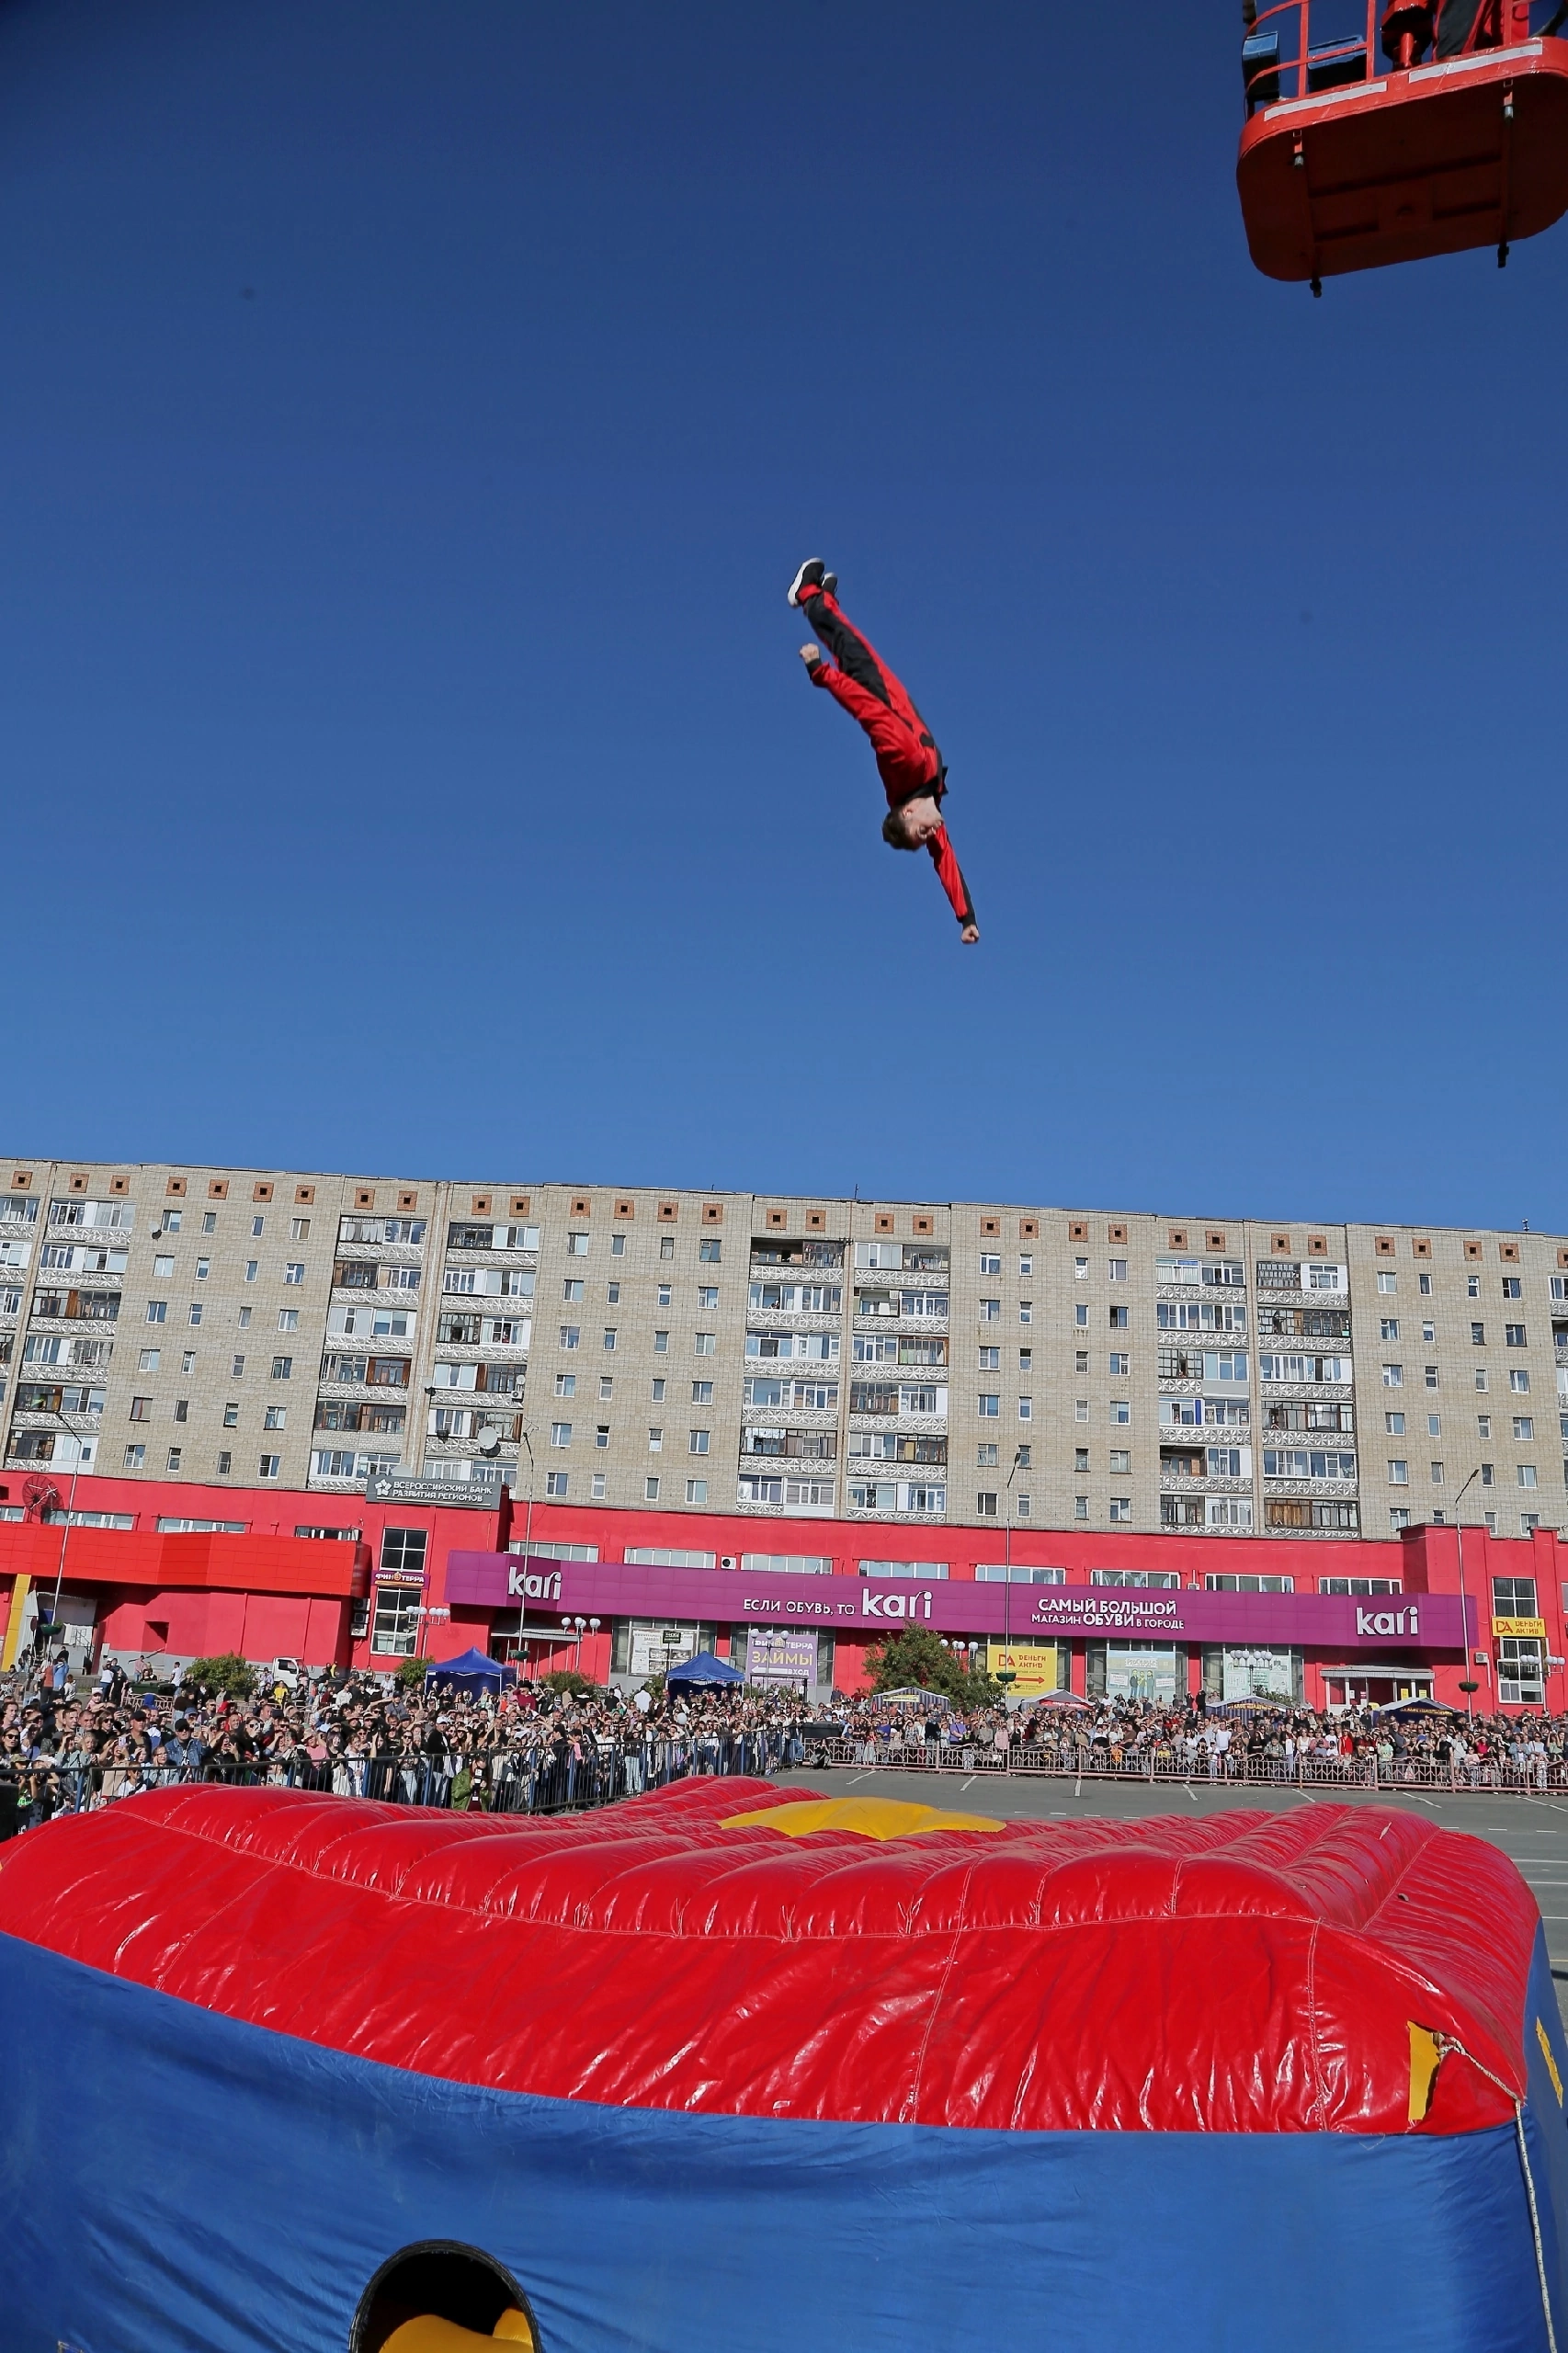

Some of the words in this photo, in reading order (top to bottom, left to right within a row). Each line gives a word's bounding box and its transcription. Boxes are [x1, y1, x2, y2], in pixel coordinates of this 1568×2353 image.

[392, 1489, 436, 1499] РАЗВИТИЯ
[437, 1492, 483, 1502] РЕГИОНОВ
[393, 1481, 467, 1493] ВСЕРОССИЙСКИЙ
[470, 1485, 493, 1495] БАНК
[508, 1566, 562, 1600] kari
[744, 1598, 780, 1611] ЕСЛИ
[786, 1600, 834, 1616] ОБУВЬ,
[836, 1603, 855, 1615] ТО
[861, 1587, 932, 1618] kari
[1038, 1597, 1096, 1613] САМЫЙ
[1099, 1599, 1176, 1615] БОЛЬШОЙ
[1031, 1613, 1081, 1625] МАГАЗИН
[1083, 1613, 1134, 1627] ОБУВИ
[1136, 1619, 1142, 1627] В
[1144, 1619, 1184, 1630] ГОРОДЕ
[1356, 1606, 1418, 1635] kari
[751, 1648, 813, 1666] ЗАЙМЫ
